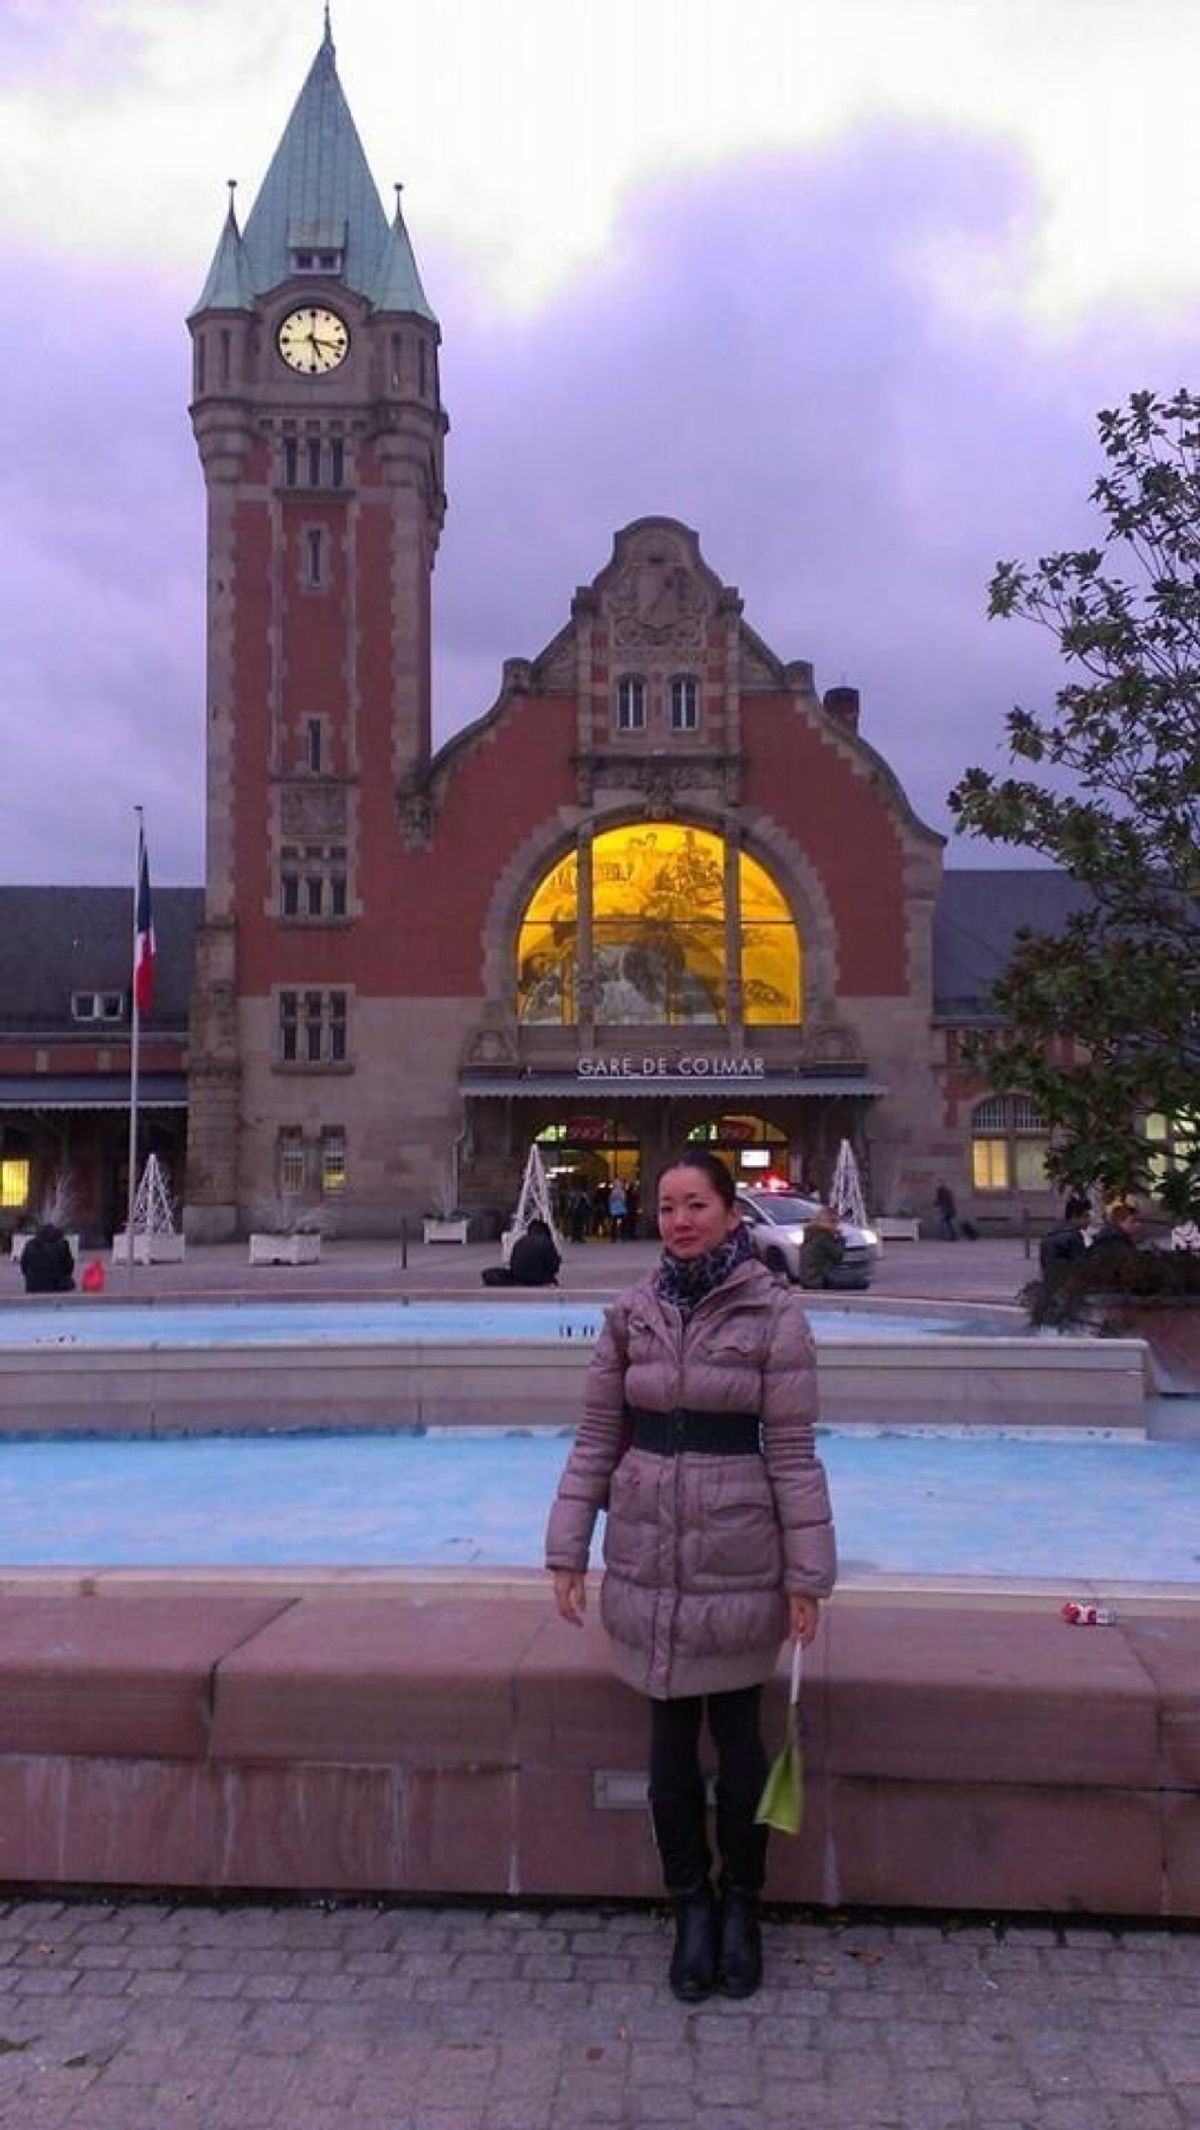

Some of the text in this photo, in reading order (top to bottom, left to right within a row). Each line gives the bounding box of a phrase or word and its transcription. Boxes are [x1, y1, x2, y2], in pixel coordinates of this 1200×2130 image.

[577, 1057, 765, 1076] GARE DE COLMAR
